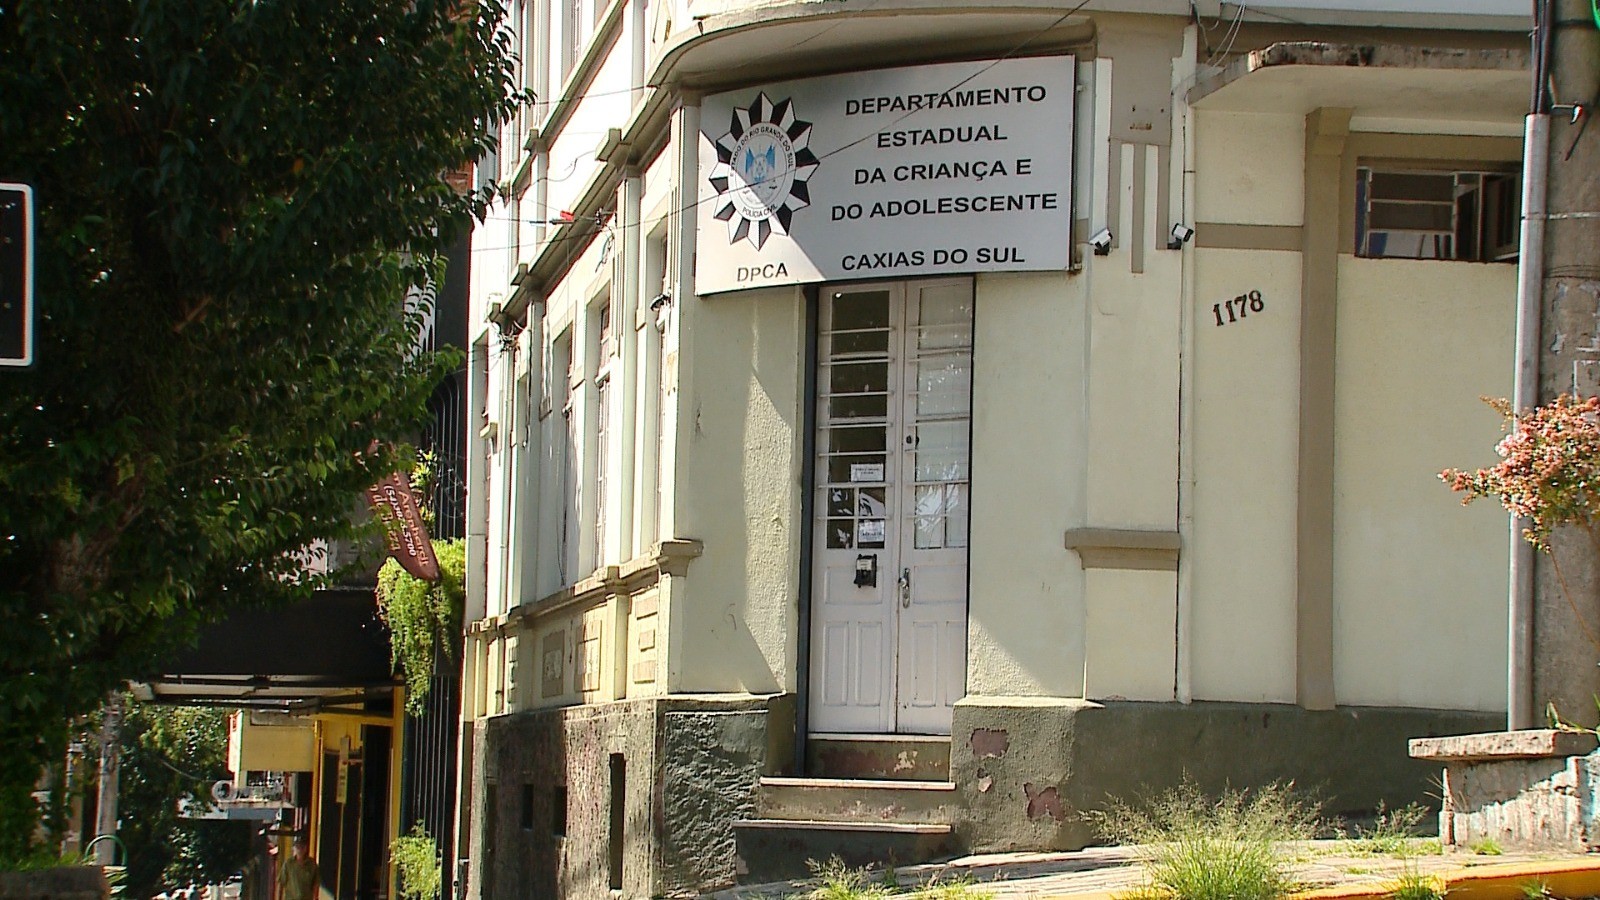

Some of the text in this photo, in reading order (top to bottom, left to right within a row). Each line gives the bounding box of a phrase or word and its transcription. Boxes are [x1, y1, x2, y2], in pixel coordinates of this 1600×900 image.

[845, 85, 1046, 116] DEPARTAMENTO
[760, 126, 784, 141] GRANDE
[782, 140, 790, 151] DO
[786, 153, 794, 168] SUL
[877, 124, 1008, 148] ESTADUAL
[854, 158, 1032, 185] DA CRIANÇA E
[831, 193, 1058, 221] DO ADOLESCENTE
[736, 262, 789, 282] DPCA
[841, 247, 1026, 271] CAXIAS DO SUL
[1213, 289, 1264, 327] 1178
